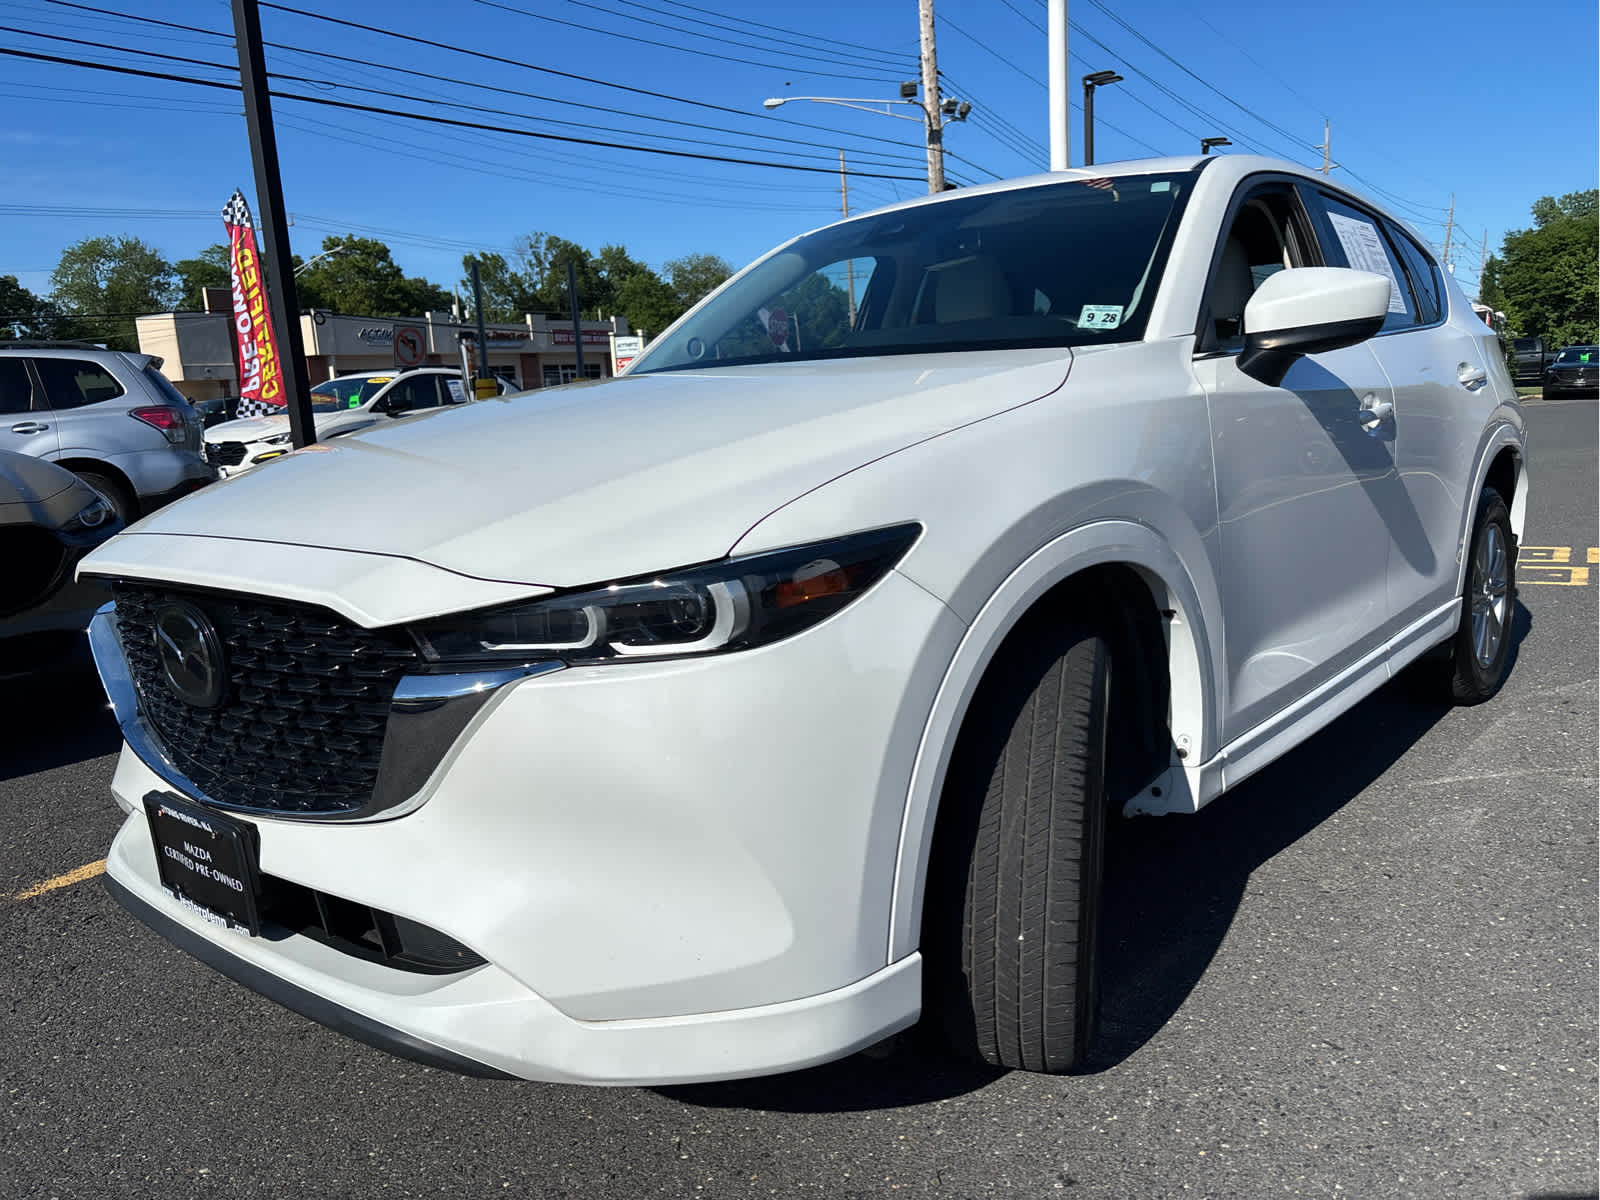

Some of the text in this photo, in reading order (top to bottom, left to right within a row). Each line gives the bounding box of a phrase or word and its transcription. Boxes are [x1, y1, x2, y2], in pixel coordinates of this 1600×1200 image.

[1087, 313, 1118, 323] 9 28
[183, 841, 212, 863] MAZDA
[164, 845, 243, 892] CERTIFIED PRE-OWNED
